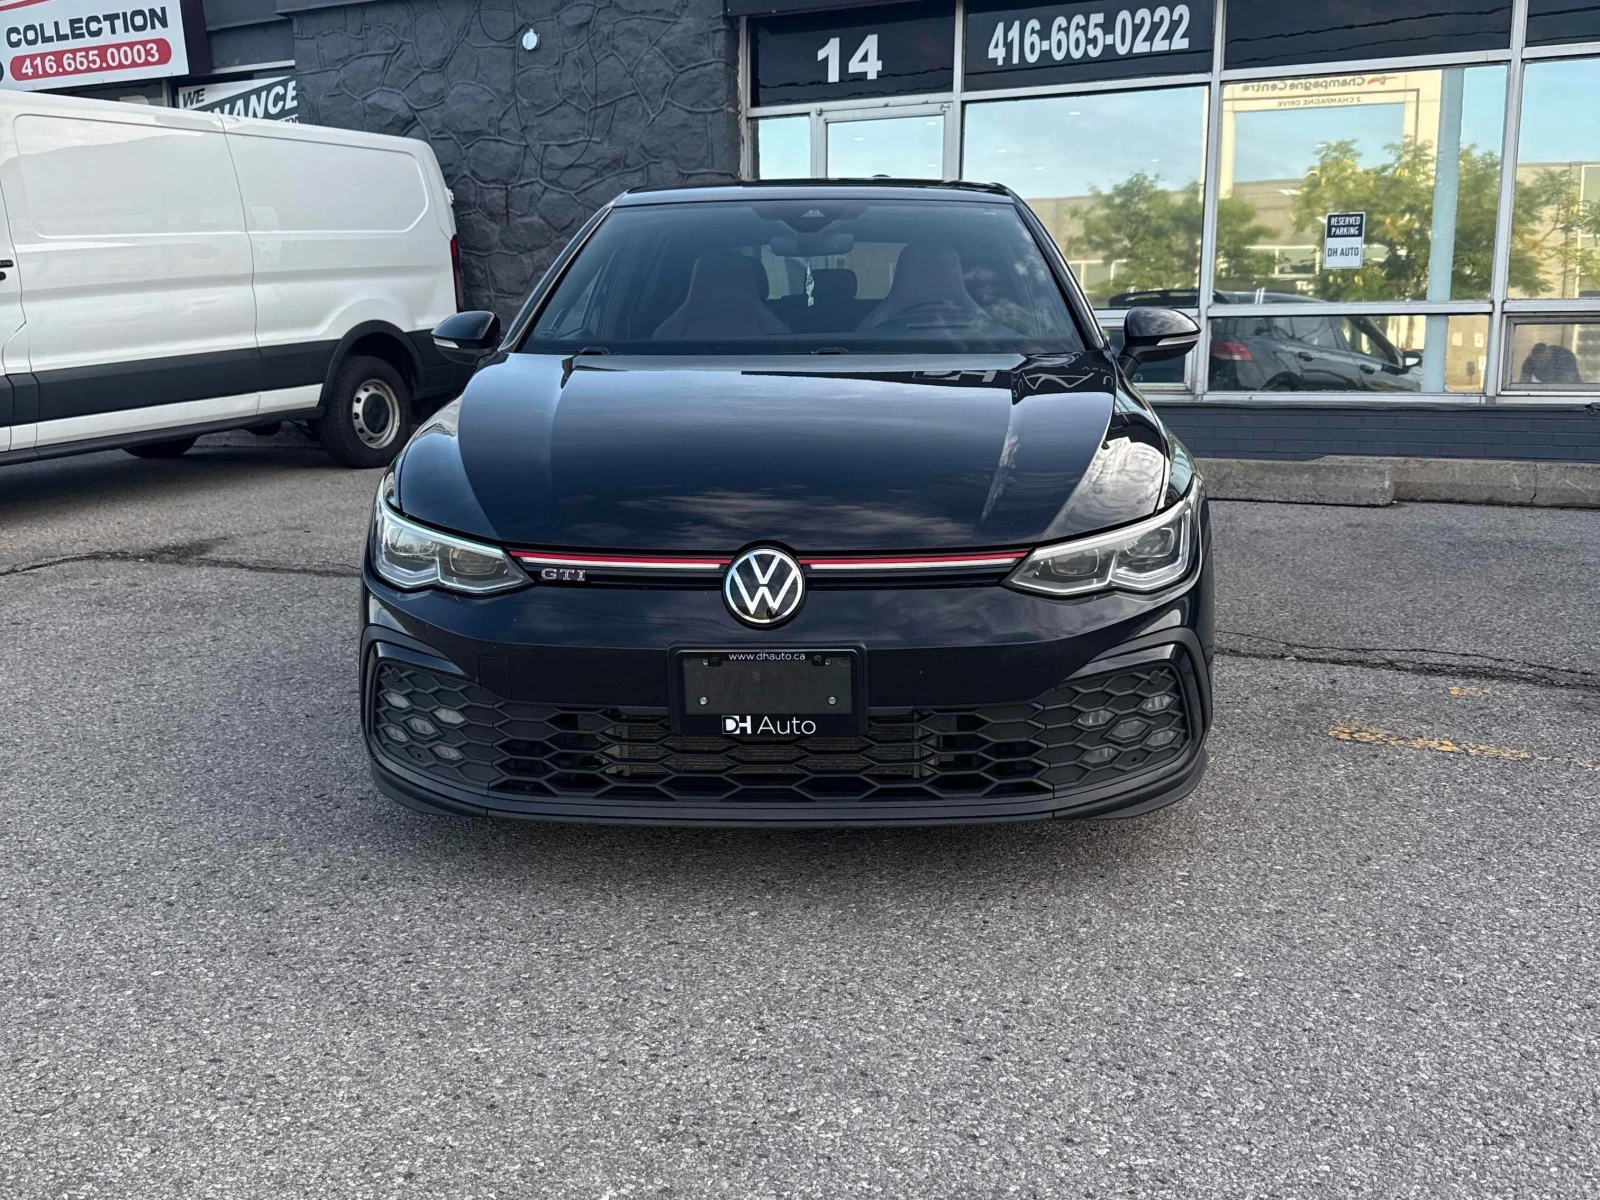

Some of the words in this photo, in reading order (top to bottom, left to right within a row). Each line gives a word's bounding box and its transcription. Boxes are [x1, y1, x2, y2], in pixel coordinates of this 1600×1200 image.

[6, 6, 169, 49] COLLECTION
[987, 4, 1190, 65] 416-665-0222
[21, 43, 160, 77] 416.665.0003
[817, 34, 882, 82] 14
[182, 87, 206, 107] WE
[1330, 216, 1361, 226] RESERVED
[1331, 226, 1359, 236] PARKING
[1327, 247, 1338, 257] DH
[1340, 246, 1360, 257] AUTO
[540, 568, 586, 582] GTI
[728, 651, 806, 661] www.dhauto.ca
[721, 715, 752, 735] DH
[757, 715, 817, 735] Auto
